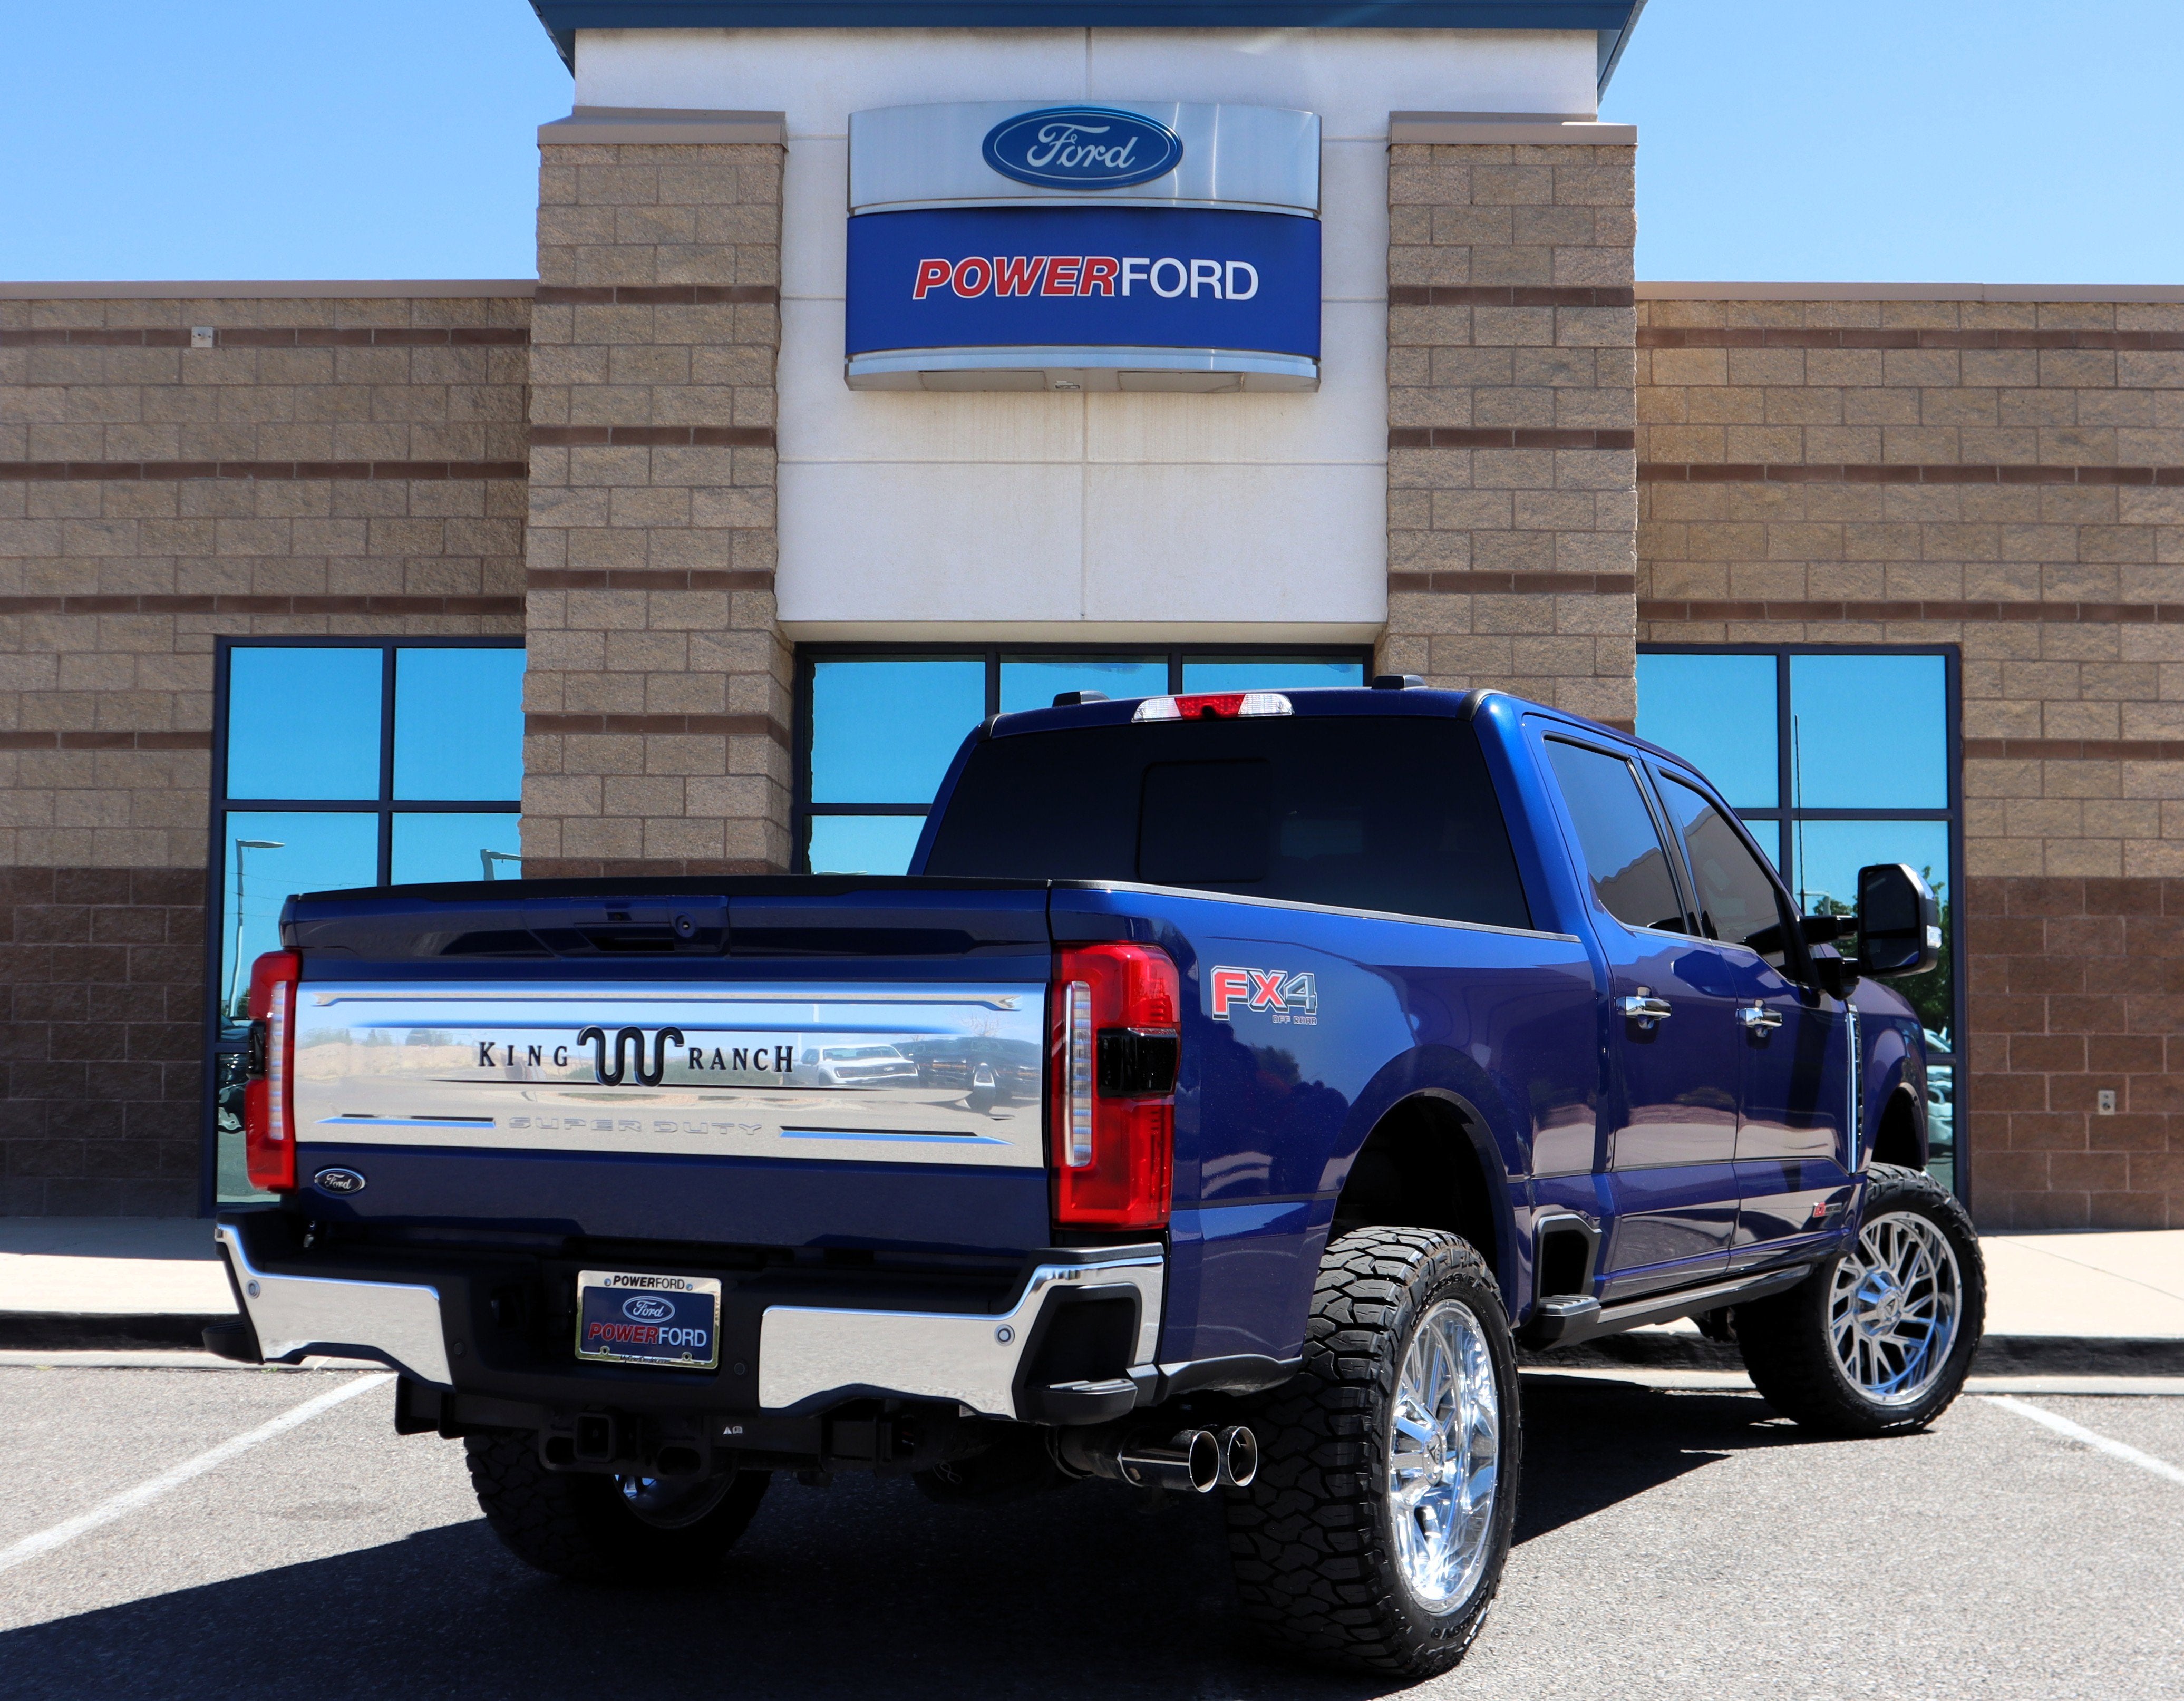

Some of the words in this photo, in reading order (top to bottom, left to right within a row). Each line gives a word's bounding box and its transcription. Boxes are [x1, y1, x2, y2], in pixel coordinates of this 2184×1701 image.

[1026, 122, 1136, 169] Ford
[1210, 965, 1318, 1022] FX4
[1272, 1015, 1291, 1024] OFF
[1293, 1015, 1317, 1025] ROAD
[478, 1041, 568, 1067] KING
[688, 1045, 794, 1073] RANCH
[508, 1116, 643, 1132] SUPER
[653, 1121, 762, 1135] DUTY
[324, 1173, 353, 1189] Ford
[633, 1300, 664, 1318] Ford
